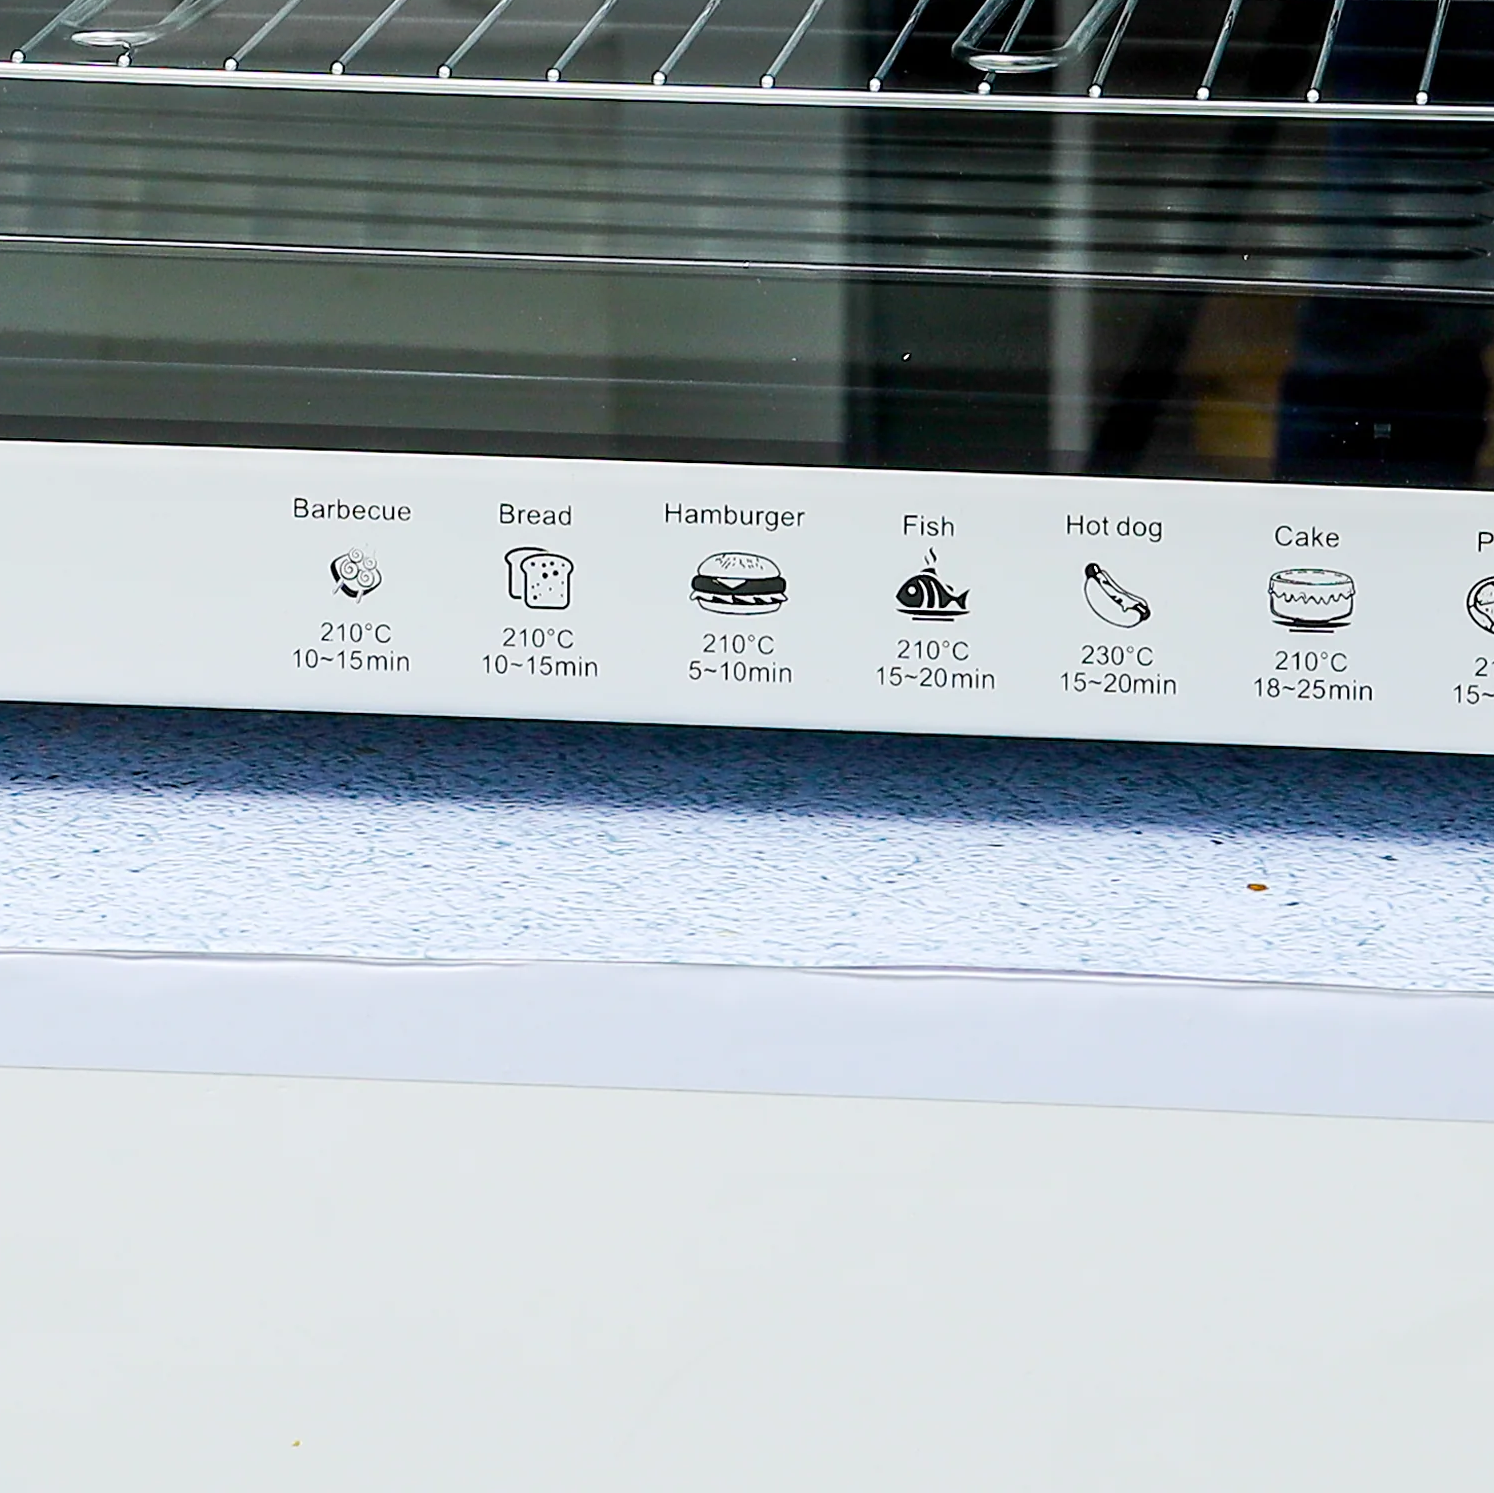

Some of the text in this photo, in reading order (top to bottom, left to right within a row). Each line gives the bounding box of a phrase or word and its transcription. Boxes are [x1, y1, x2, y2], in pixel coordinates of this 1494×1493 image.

[293, 497, 412, 522] Barbecue
[499, 502, 572, 527] Bread
[665, 502, 806, 532] Hamburger
[903, 514, 955, 537] Fish
[1066, 514, 1163, 543] Hot dog
[1274, 525, 1340, 548] Cake
[320, 621, 392, 644] 210°C
[502, 627, 574, 650] 210°C
[702, 633, 775, 656] 210°C
[292, 648, 410, 672] 10~15min
[897, 639, 969, 662] 210°C
[1081, 644, 1154, 667] 230°C
[1275, 650, 1348, 673] 210°C
[482, 654, 598, 678] 10~15min
[688, 660, 792, 684] 5~10min
[876, 666, 995, 690] 15~20min
[1060, 671, 1177, 695] 15~20min
[1253, 677, 1373, 702] 18~25min
